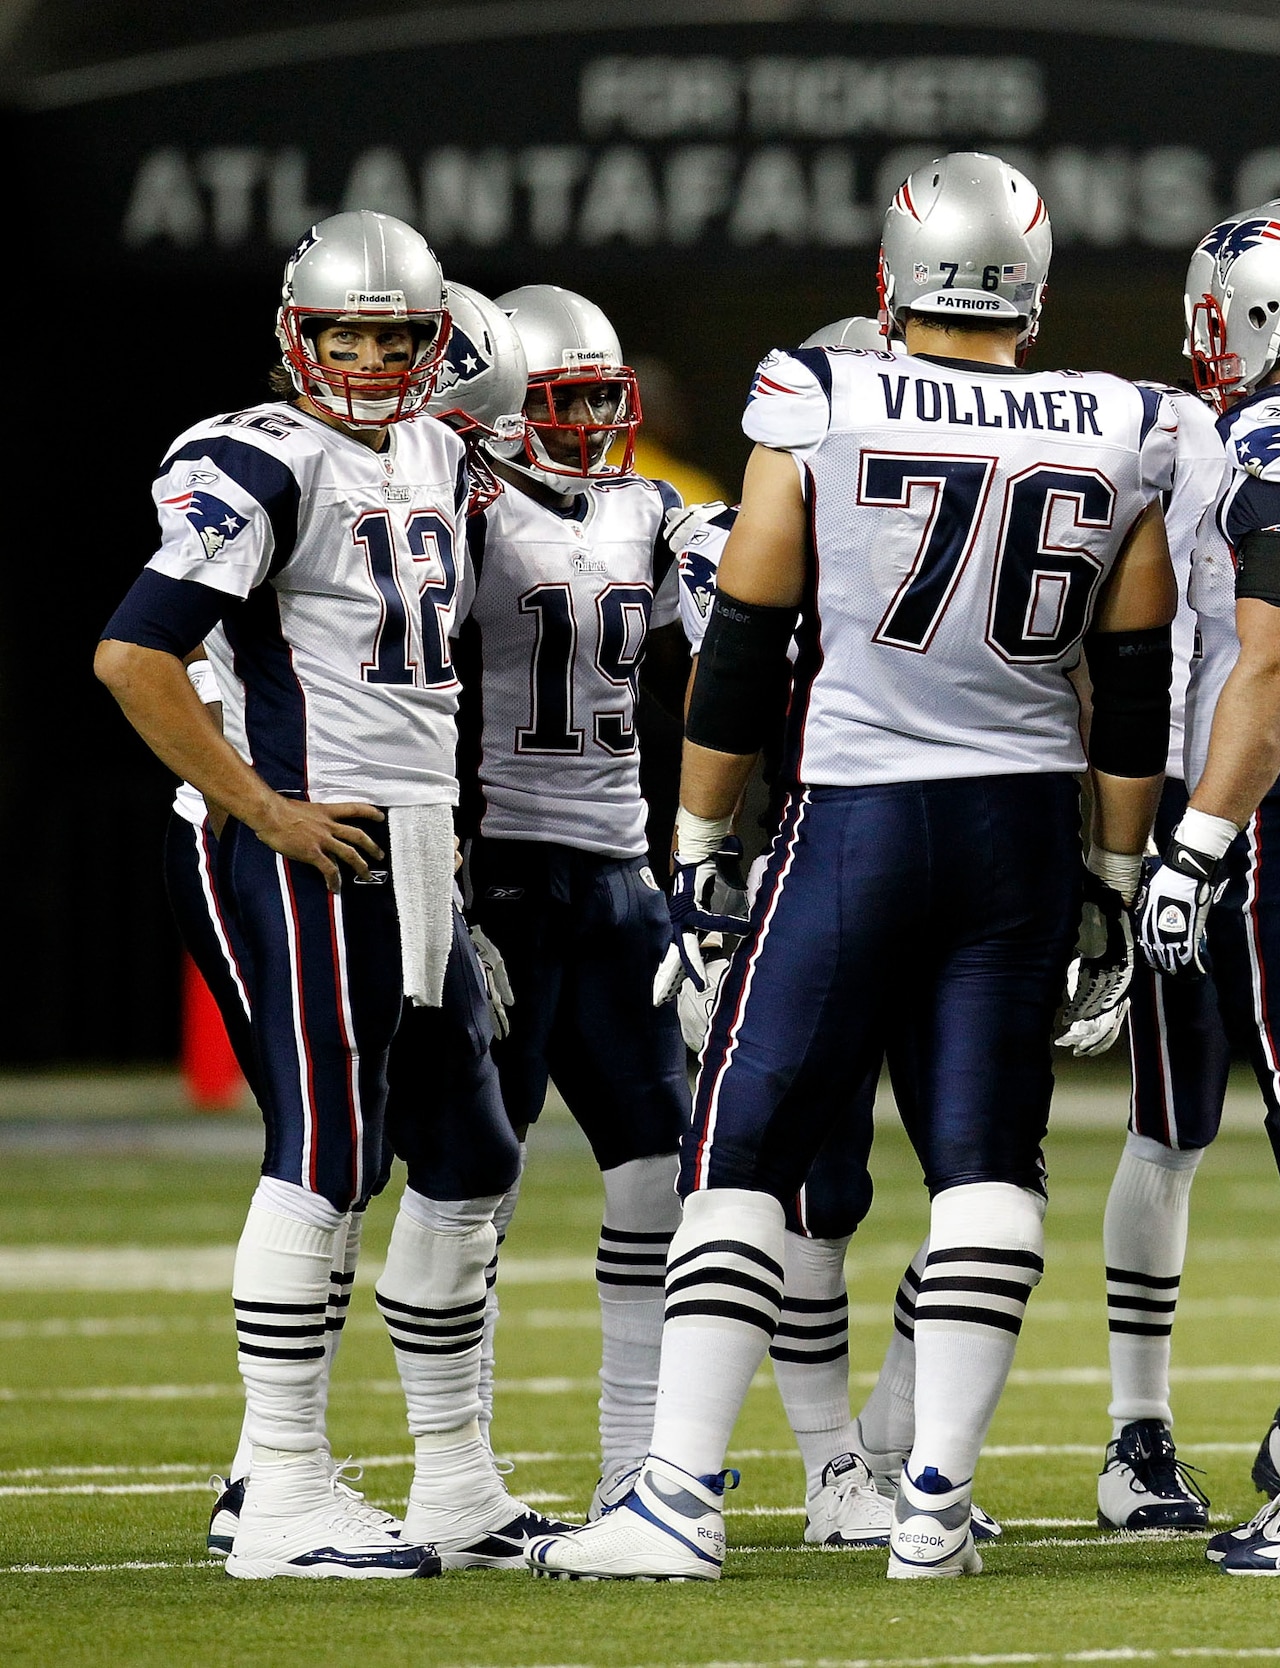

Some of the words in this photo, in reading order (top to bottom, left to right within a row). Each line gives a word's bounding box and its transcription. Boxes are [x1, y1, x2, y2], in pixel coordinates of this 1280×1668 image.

[359, 294, 391, 303] Riddell
[937, 296, 1000, 311] PATRIOTS
[577, 352, 604, 361] Riddell
[877, 373, 1103, 437] VOLLMER
[857, 449, 1117, 665] 76
[352, 509, 459, 689] 12
[514, 582, 654, 757] 19
[898, 1532, 945, 1548] Reebok
